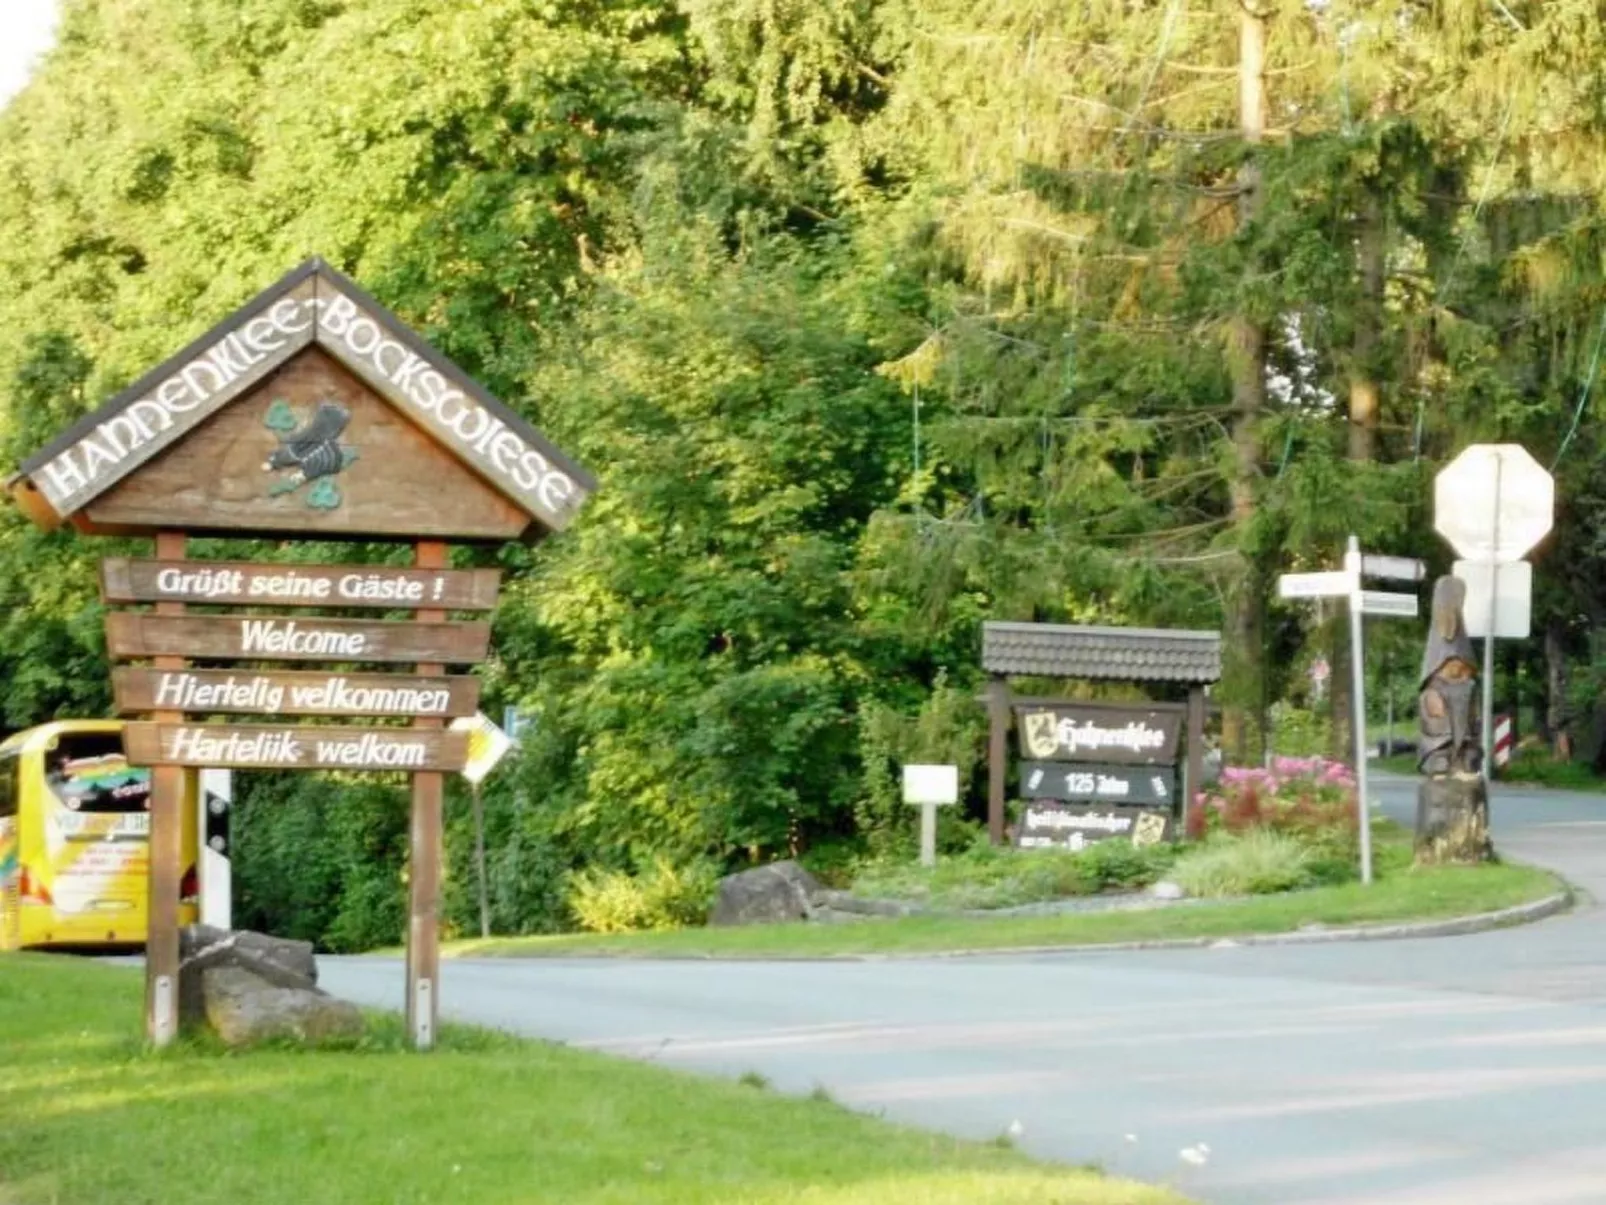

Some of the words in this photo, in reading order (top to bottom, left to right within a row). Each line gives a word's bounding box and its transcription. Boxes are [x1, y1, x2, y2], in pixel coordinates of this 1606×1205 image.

[157, 567, 243, 598] Grüßt
[248, 571, 330, 599] seine
[338, 574, 424, 600] Gäste
[433, 577, 445, 600] !
[240, 619, 366, 654] Welcome
[291, 677, 450, 713] velkommen
[316, 732, 425, 766] welkom
[1064, 772, 1095, 794] 125
